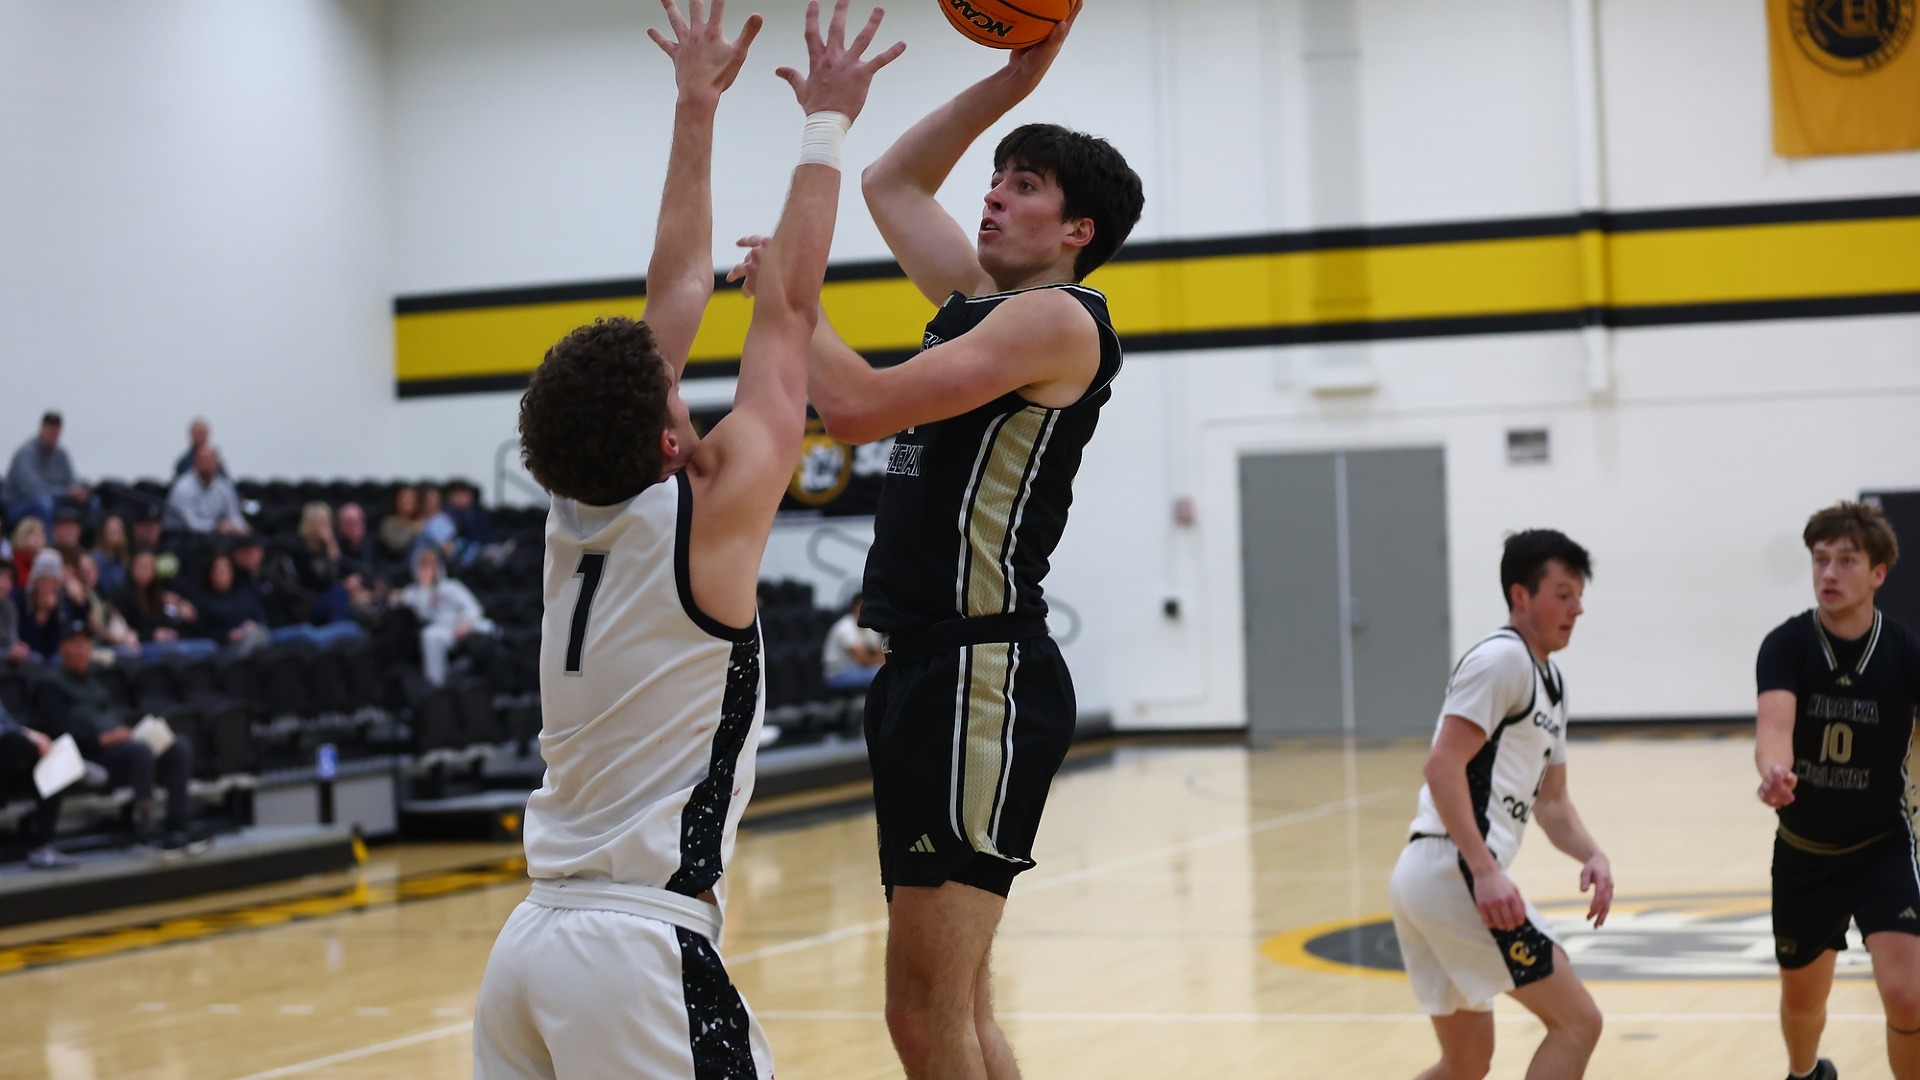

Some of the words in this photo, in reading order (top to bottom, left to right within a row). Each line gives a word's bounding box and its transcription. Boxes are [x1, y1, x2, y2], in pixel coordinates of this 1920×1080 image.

[950, 0, 1015, 37] NCAA
[563, 549, 610, 677] 1
[1820, 722, 1853, 764] 10
